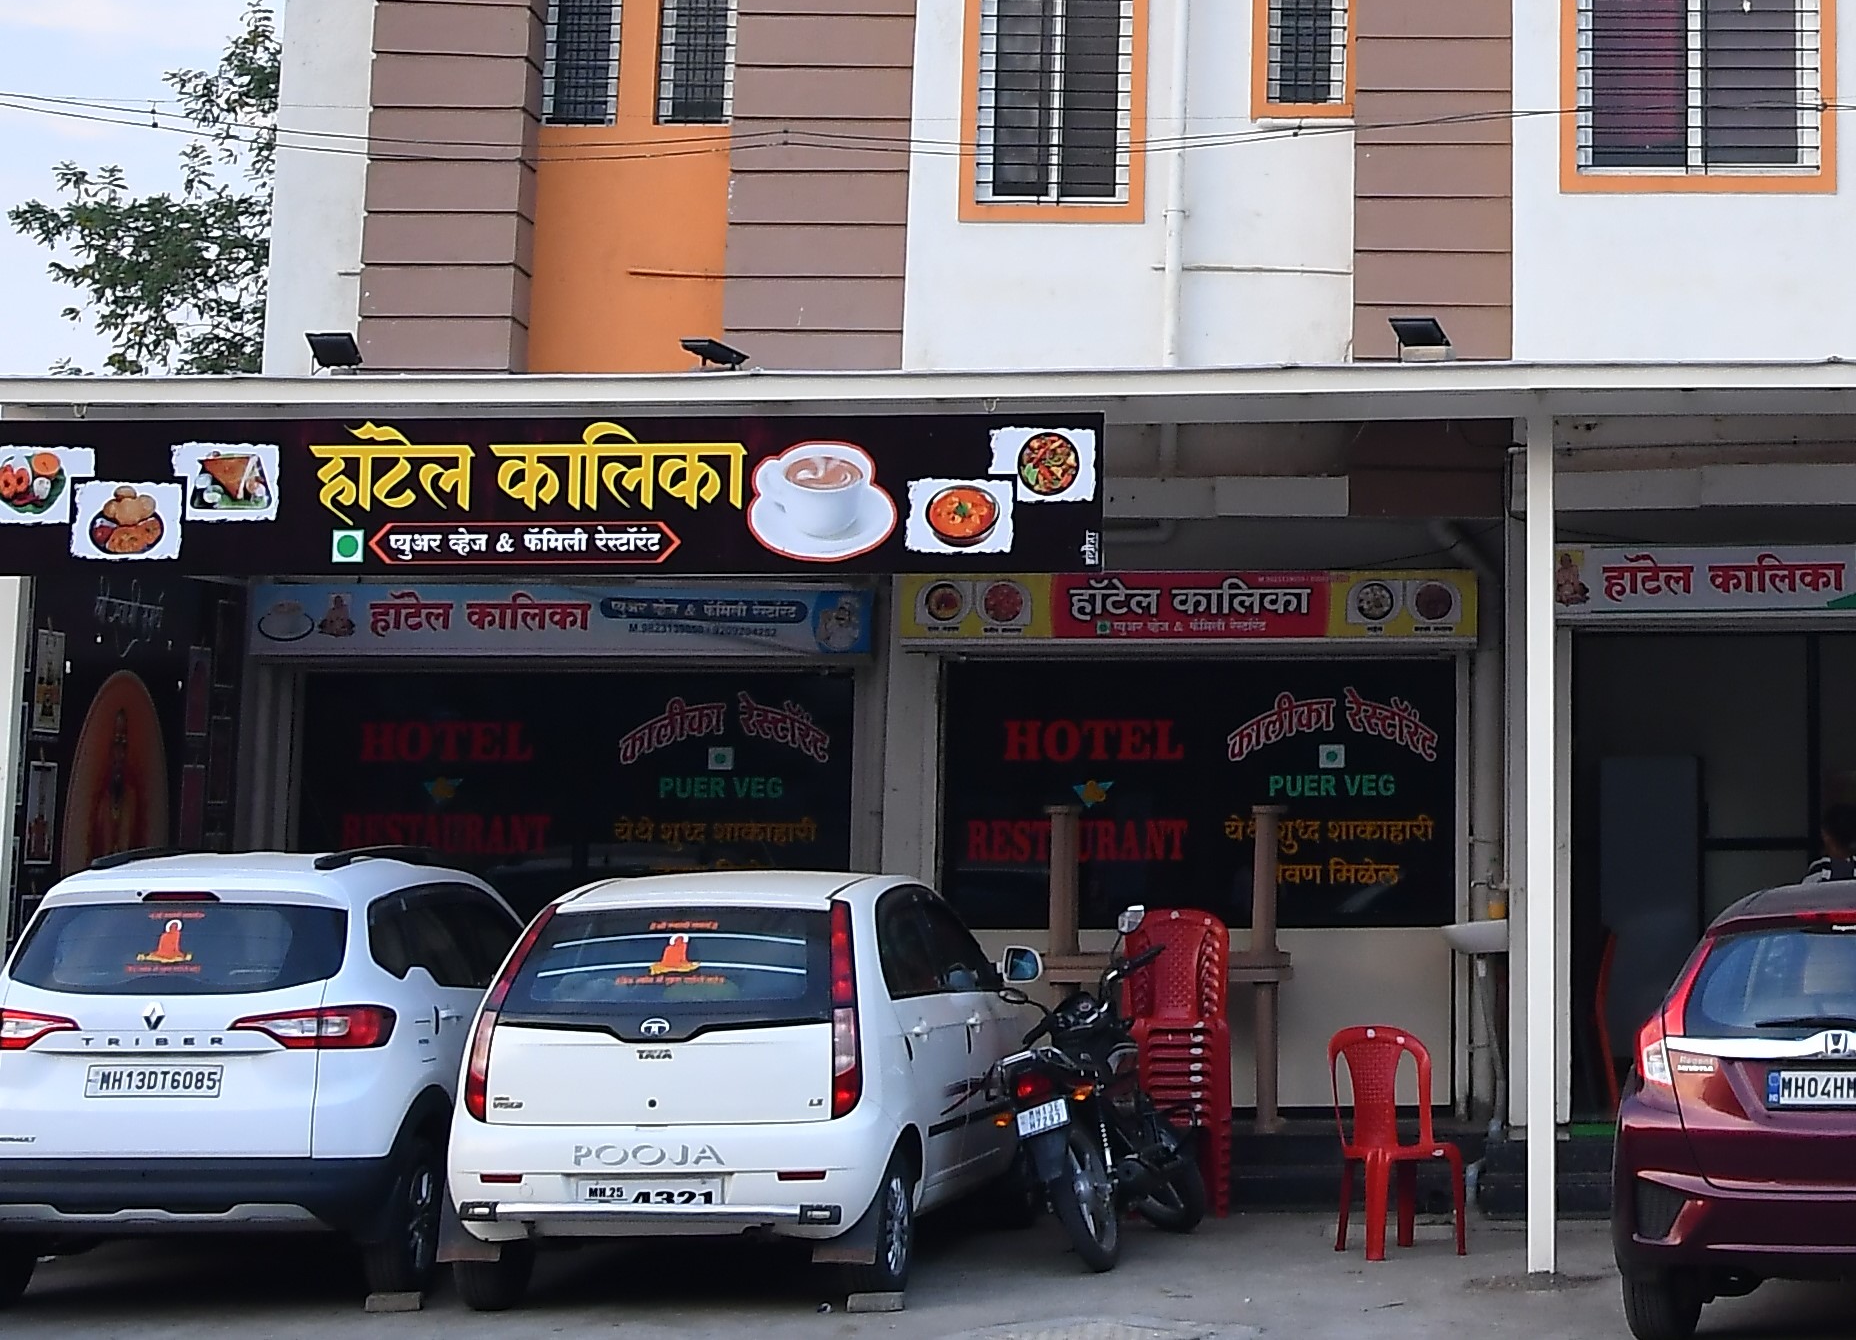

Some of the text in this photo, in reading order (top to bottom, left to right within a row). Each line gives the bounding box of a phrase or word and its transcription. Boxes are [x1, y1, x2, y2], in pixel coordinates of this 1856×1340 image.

[309, 421, 748, 525] हॉटेल कालिका
[389, 536, 441, 560] प्युअर
[448, 533, 487, 555] व्हेज
[495, 537, 516, 553] &
[1603, 554, 1846, 602] हॉटेल कालिका
[369, 590, 592, 636] हॉटेल कालिका
[1069, 578, 1312, 620] हॉटेल कालिका
[360, 720, 533, 763] HOTEL
[619, 696, 727, 765] कालीका
[1003, 718, 1185, 762] HOTEL
[1228, 691, 1337, 762] कालीका
[658, 776, 784, 799] PUER VEG
[1268, 774, 1396, 797] PUER VEG
[966, 818, 1189, 864] RESTURANT
[1327, 814, 1435, 845] शाकाहारी
[1328, 856, 1401, 887] मिळेल
[82, 1036, 224, 1047] TRIBER
[636, 1049, 673, 1061] TATA
[99, 1070, 219, 1091] MH13DT6085
[573, 1143, 727, 1167] POOJA
[588, 1185, 624, 1198] MH.25
